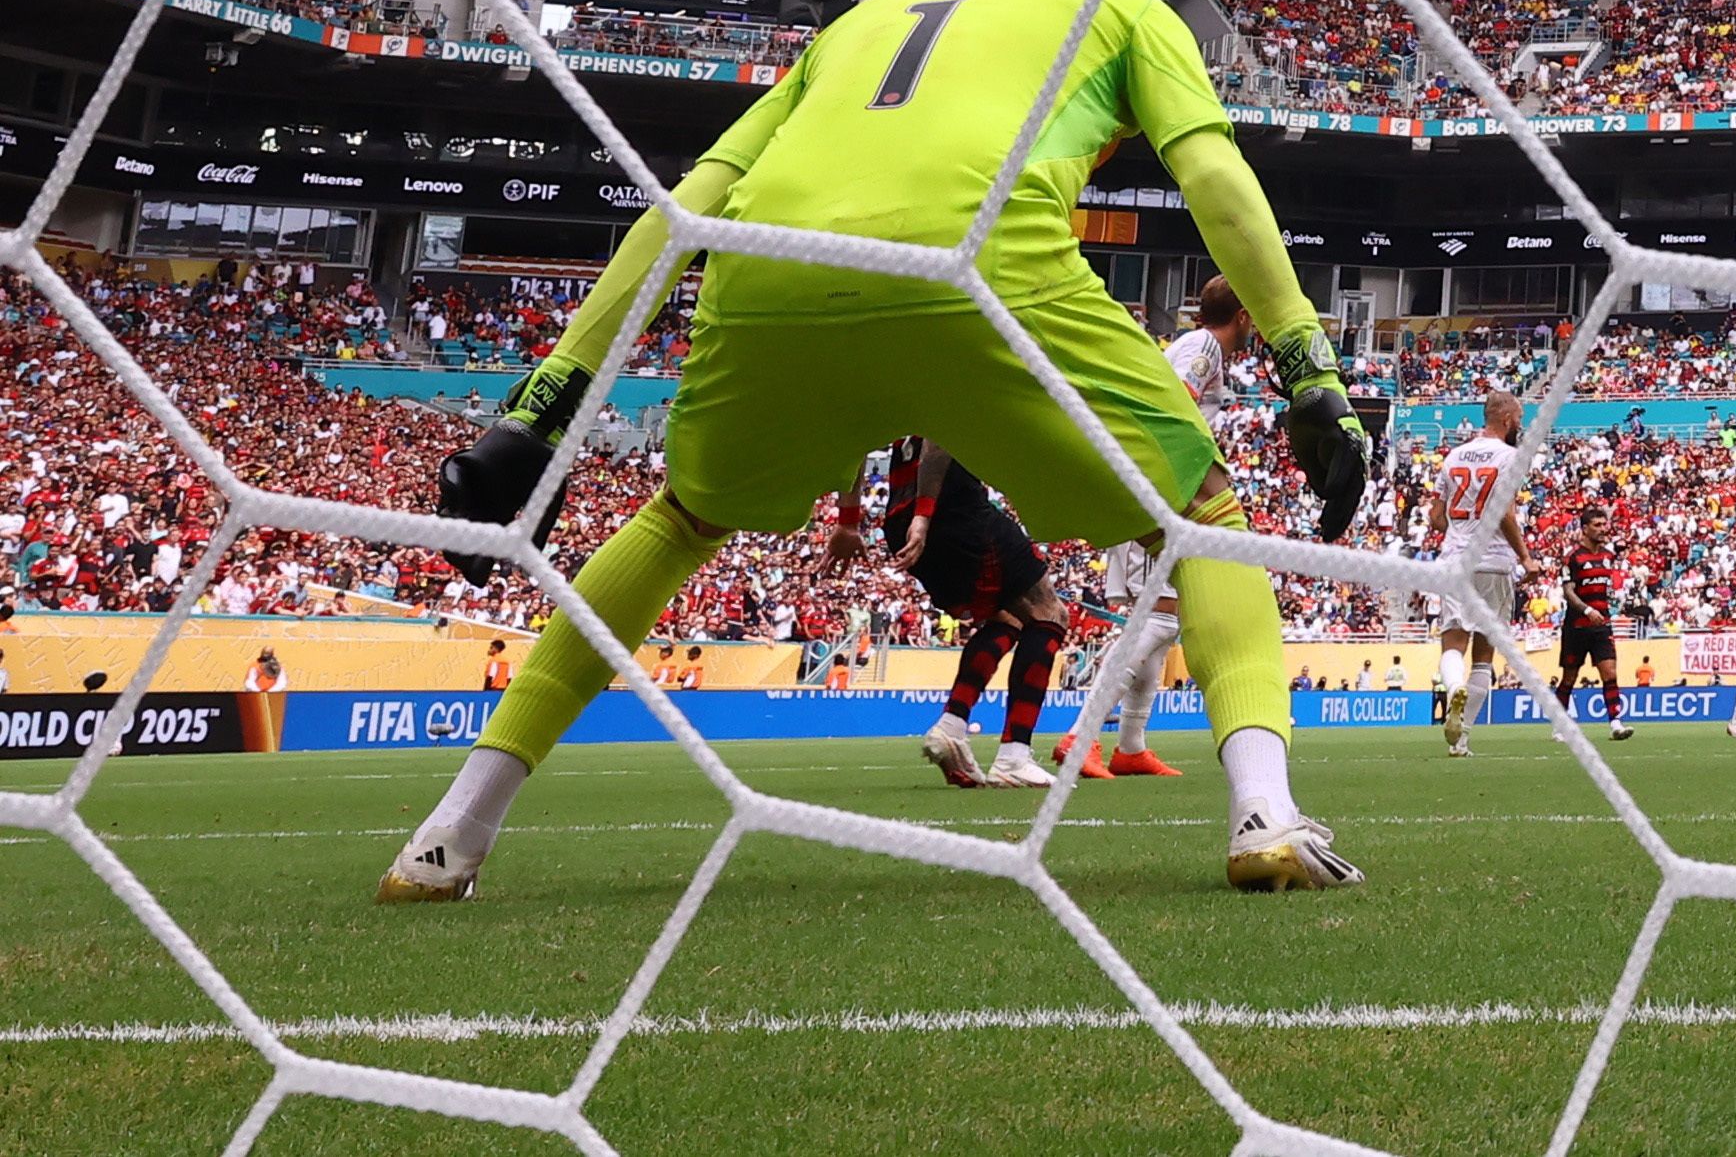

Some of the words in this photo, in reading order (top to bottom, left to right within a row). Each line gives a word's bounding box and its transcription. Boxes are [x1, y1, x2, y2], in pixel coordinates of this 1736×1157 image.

[225, 0, 270, 29] LITTLE
[270, 12, 292, 35] 66
[442, 41, 531, 68] DWIGHT
[559, 53, 682, 78] TEPHENSON
[689, 61, 720, 80] 57
[1270, 109, 1319, 129] WEBB
[1327, 114, 1351, 131] 78
[1442, 120, 1479, 136] BOB
[1601, 115, 1627, 132] 73
[115, 156, 155, 175] Betano
[302, 172, 364, 188] Hisense
[404, 177, 463, 194] Lenovo
[528, 183, 561, 201] PIF
[1294, 234, 1324, 245] airbnb
[1361, 237, 1391, 246] ULTRA
[1506, 237, 1552, 249] Betano
[1660, 233, 1706, 244] Hisense
[1458, 450, 1493, 462] LAIMER
[1449, 467, 1499, 521] 27
[1702, 637, 1724, 652] RED
[1321, 696, 1349, 722] FIFA
[1353, 696, 1407, 721] COLLECT
[348, 701, 416, 743] FIFA
